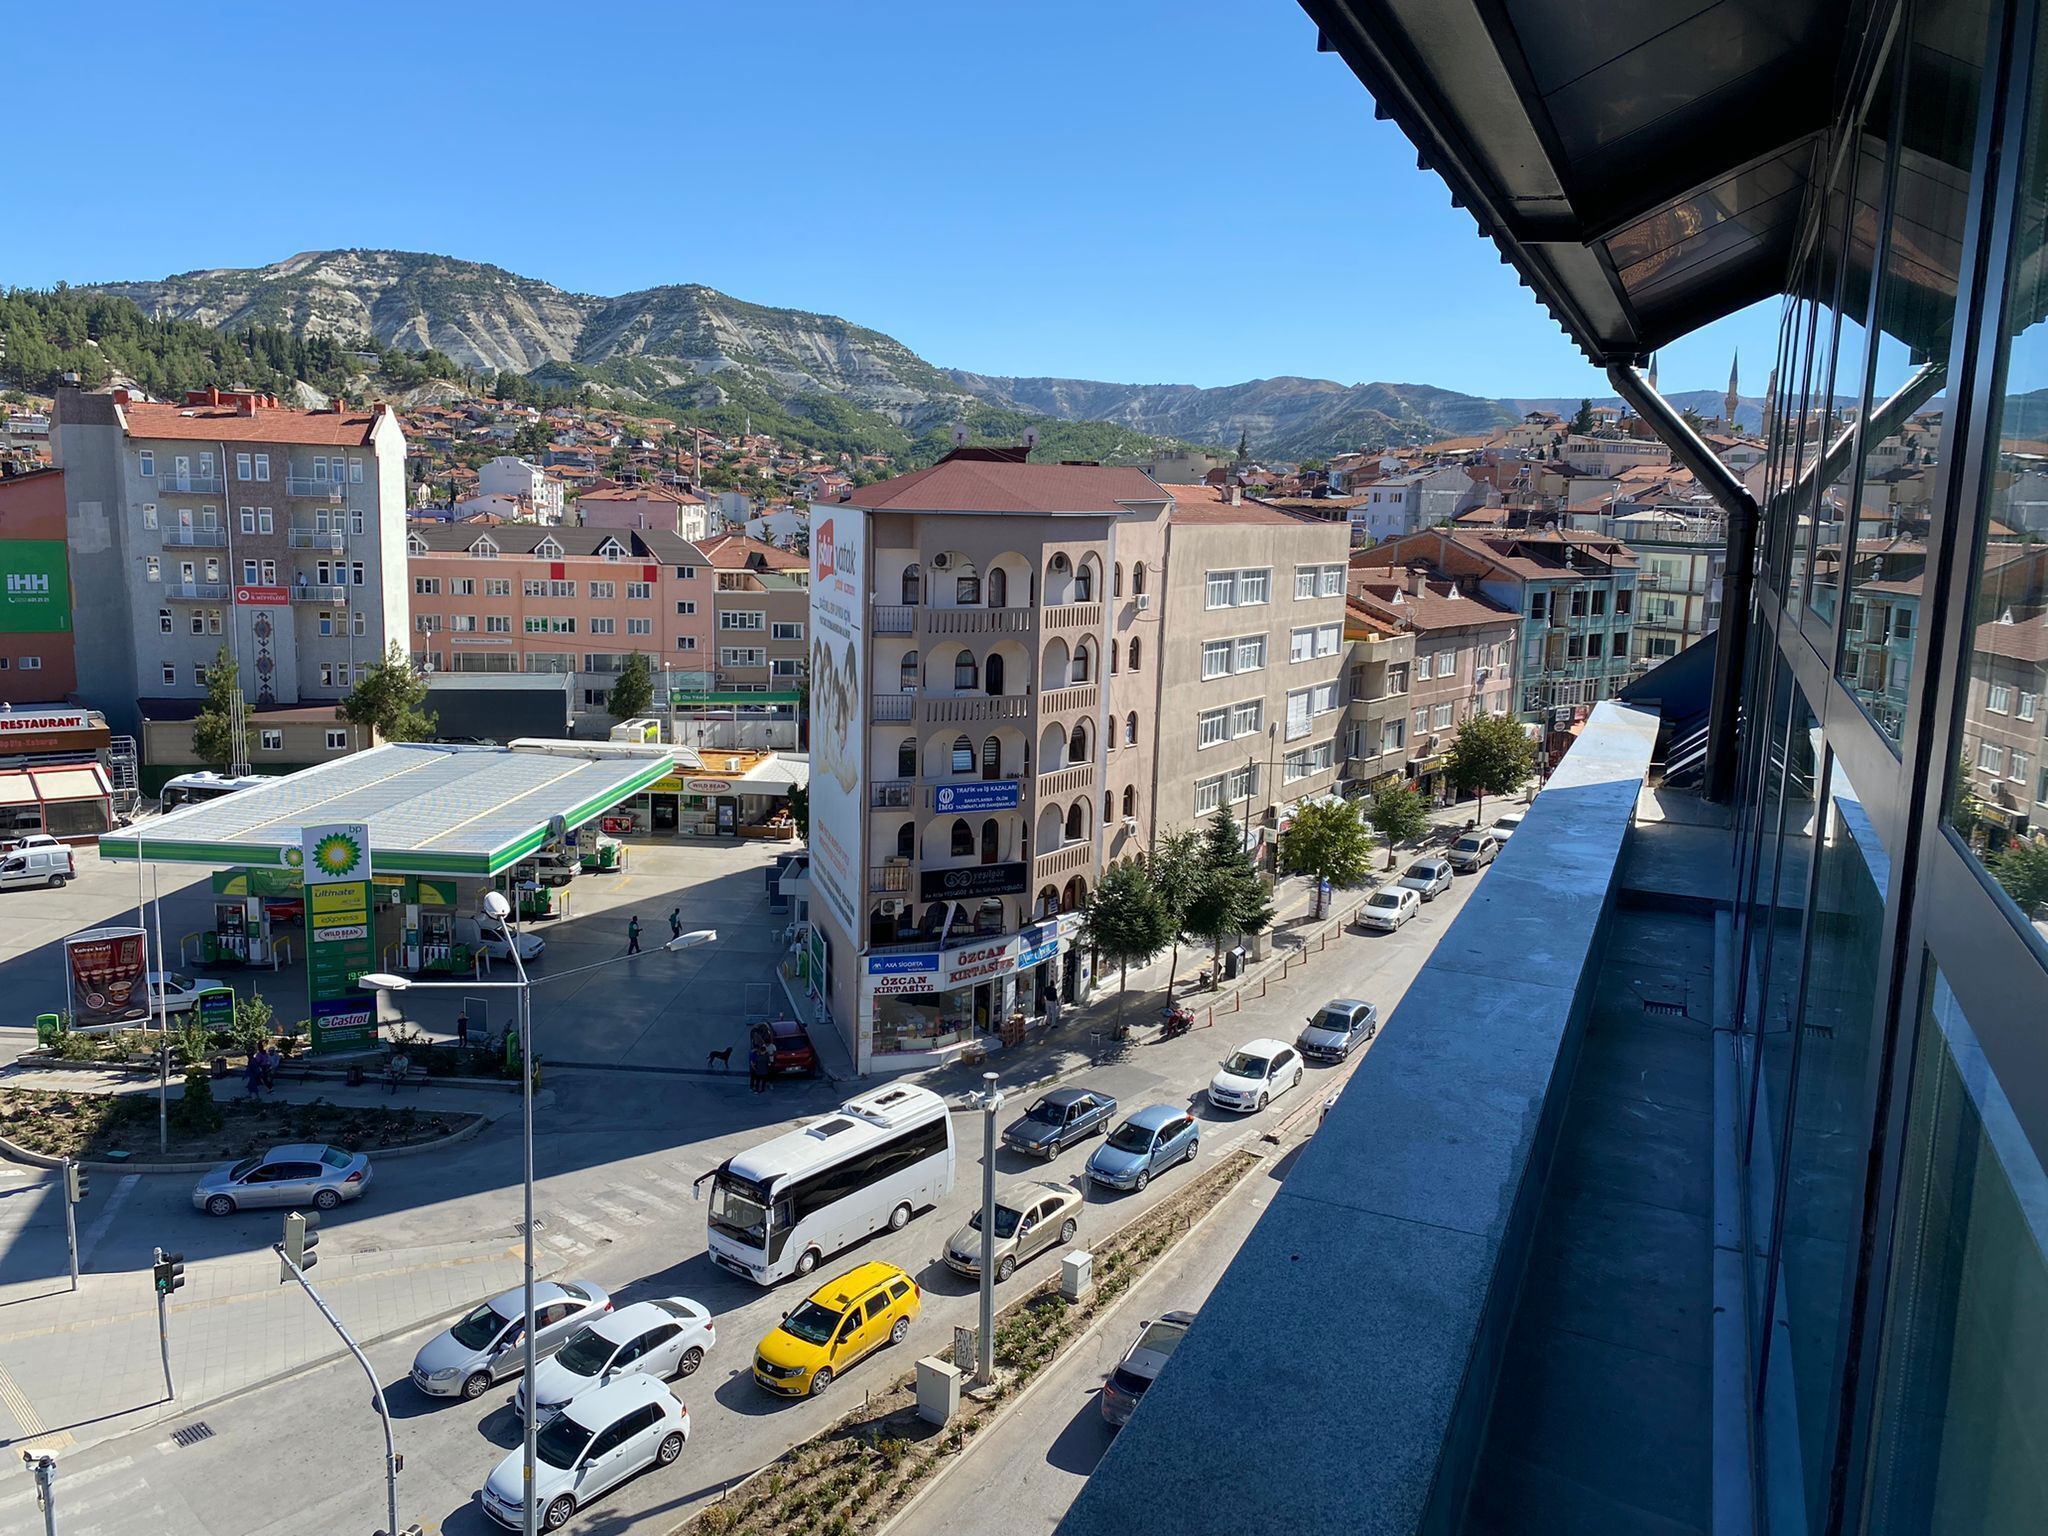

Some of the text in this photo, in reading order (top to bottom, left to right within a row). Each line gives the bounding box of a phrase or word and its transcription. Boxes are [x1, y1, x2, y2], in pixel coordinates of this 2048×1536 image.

[0, 717, 81, 730] RESTAURANT
[348, 825, 362, 834] bp
[314, 888, 355, 898] ultimate
[958, 945, 1007, 966] ÖZCAN
[898, 960, 923, 968] SİGORTA
[949, 957, 1015, 983] KIRTASİYE
[881, 976, 927, 986] ÖZCAN
[874, 984, 934, 994] KIRTASİYE
[331, 1014, 368, 1027] Castrol
